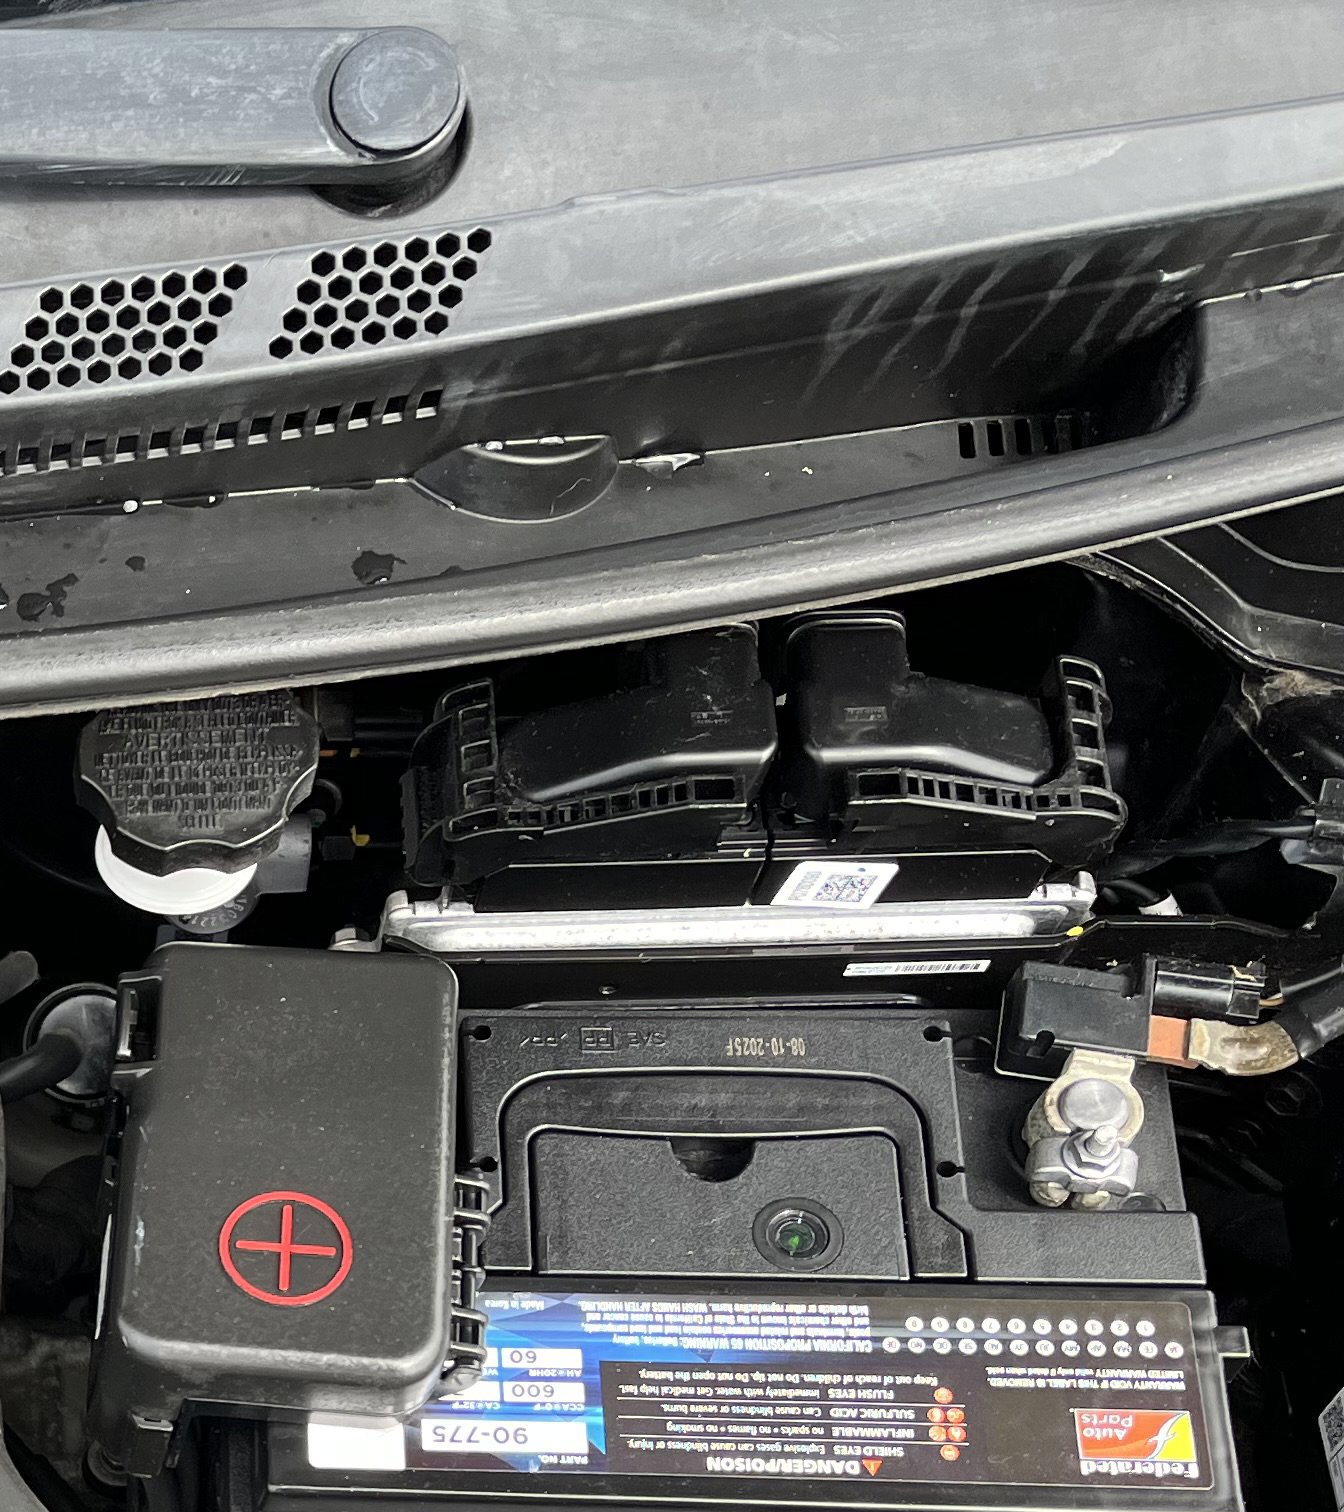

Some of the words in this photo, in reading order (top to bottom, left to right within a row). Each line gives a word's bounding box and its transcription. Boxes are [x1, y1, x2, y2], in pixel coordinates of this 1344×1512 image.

[725, 1037, 806, 1056] 08-10-2025F
[510, 1300, 520, 1310] in
[522, 1300, 544, 1310] Made
[731, 1338, 744, 1350] 65
[744, 1338, 812, 1351] PROPOSITION
[812, 1339, 873, 1353] CALIFORNIA
[510, 1350, 537, 1364] 60
[638, 1368, 673, 1381] battery.
[675, 1371, 690, 1382] the
[692, 1370, 715, 1381] open
[717, 1372, 733, 1382] not
[735, 1373, 749, 1382] Do
[750, 1370, 766, 1383] tip.
[767, 1373, 784, 1383] not
[785, 1374, 800, 1383] Do
[801, 1374, 841, 1385] children.
[895, 1375, 912, 1384] out
[1095, 1369, 1147, 1379] WARRANTY
[842, 1375, 853, 1385] of
[855, 1375, 881, 1385] reach
[884, 1376, 894, 1385] of
[914, 1374, 938, 1387] Keep
[1046, 1379, 1077, 1389] LABEL
[1078, 1379, 1099, 1389] THIS
[1110, 1380, 1133, 1390] VOID
[512, 1384, 554, 1398] 600
[618, 1384, 639, 1395] fast.
[639, 1383, 659, 1395] help
[660, 1386, 695, 1396] medical
[696, 1386, 713, 1396] Get
[714, 1387, 742, 1396] water.
[1134, 1381, 1186, 1391] WARRANTY
[743, 1387, 764, 1397] with
[827, 1388, 856, 1399] EYES
[857, 1388, 894, 1399] FLUSH
[660, 1403, 688, 1415] burns.
[689, 1405, 718, 1413] severe
[719, 1405, 730, 1413] or
[731, 1405, 774, 1416] blindness
[774, 1406, 801, 1416] cause
[803, 1407, 821, 1417] Can
[829, 1407, 858, 1418] ACID
[859, 1408, 916, 1419] SULFURIC
[1080, 1413, 1133, 1427] Parts
[666, 1421, 705, 1434] smoking
[706, 1425, 718, 1433] no
[727, 1425, 758, 1436] flames
[759, 1425, 772, 1434] no
[780, 1425, 810, 1436] sparks
[811, 1426, 824, 1435] no
[831, 1426, 915, 1438] INFLAMMABLE
[432, 1425, 529, 1445] 90-775
[1082, 1427, 1127, 1441] Auto
[655, 1441, 666, 1449] or
[667, 1441, 709, 1452] blindness
[710, 1442, 736, 1451] cause
[738, 1443, 755, 1452] can
[756, 1441, 782, 1452] gases
[783, 1442, 825, 1454] Explosive
[833, 1444, 862, 1456] EYES
[863, 1445, 905, 1457] SHIELD
[537, 1454, 559, 1464] NO.
[559, 1455, 589, 1465] PART
[706, 1456, 861, 1475] DANGER/POISON
[1079, 1460, 1200, 1479] Federated
